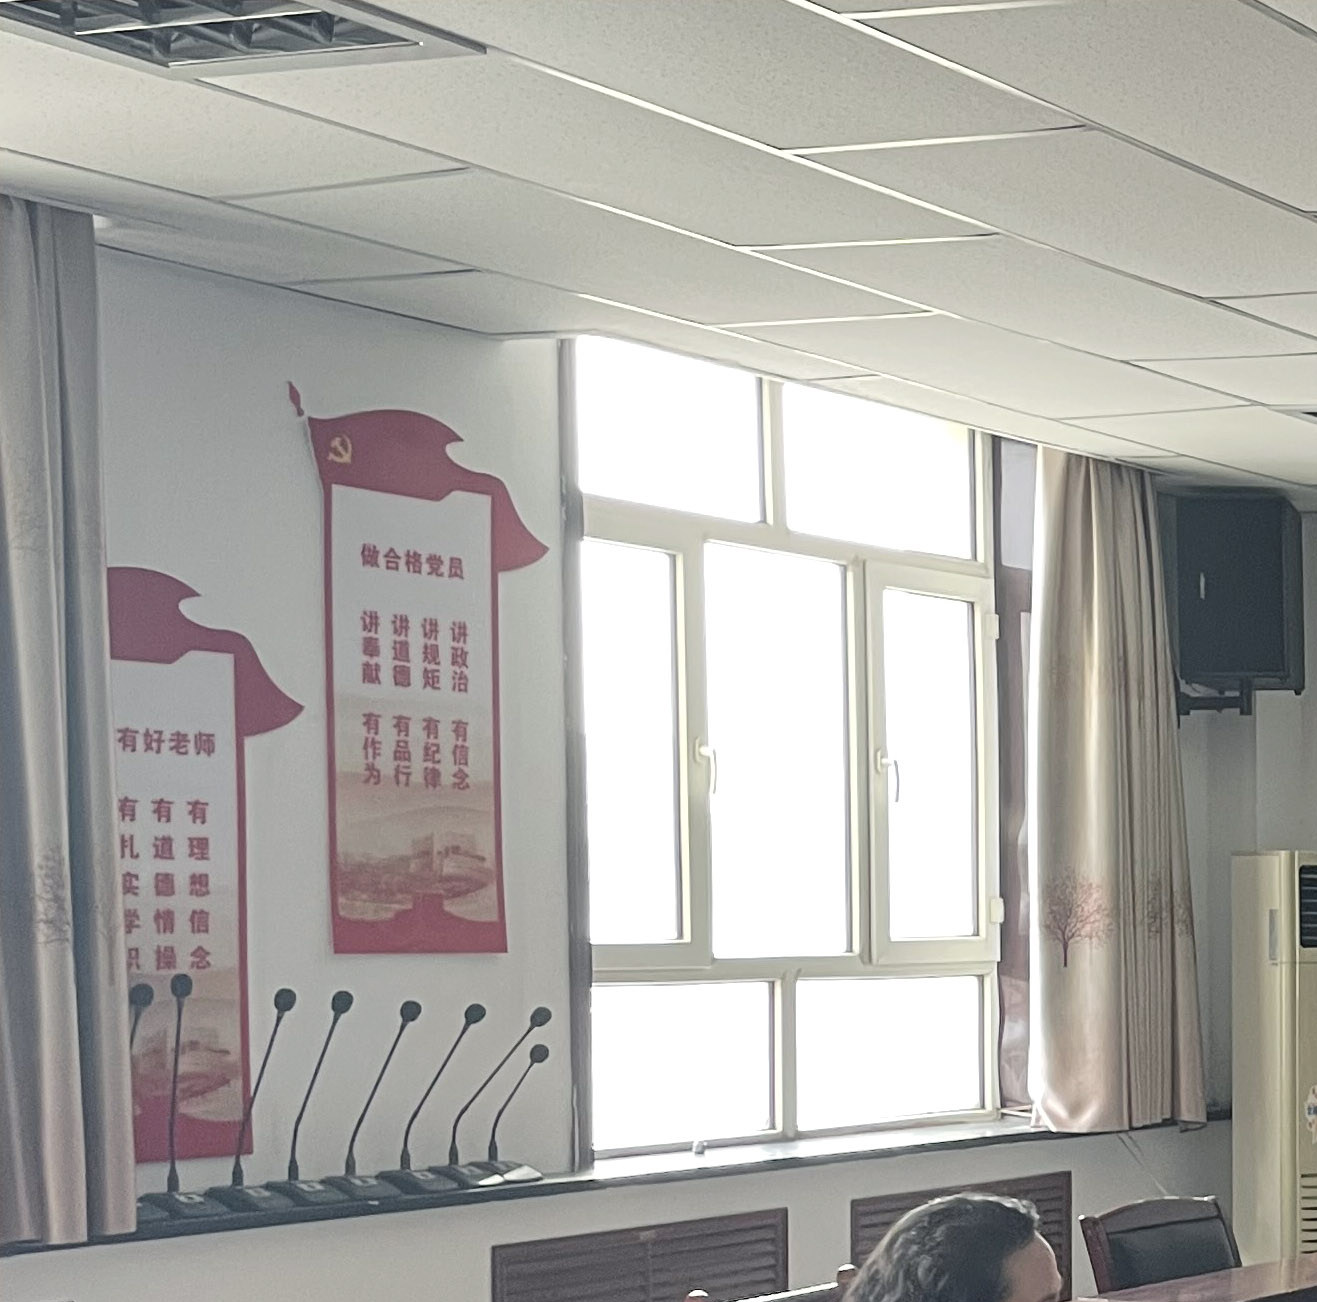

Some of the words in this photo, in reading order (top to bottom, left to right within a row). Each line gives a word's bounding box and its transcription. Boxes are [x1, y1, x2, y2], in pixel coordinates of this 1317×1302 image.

[361, 543, 464, 580] 做合格党员
[361, 610, 381, 685] 讲奉献
[391, 614, 411, 688] 讲道德
[421, 617, 441, 690] 讲规矩
[450, 621, 470, 693] 讲政治
[117, 727, 216, 757] 有好老师
[362, 712, 382, 786] 有作为
[392, 714, 412, 787] 有品行
[422, 716, 441, 790] 有纪律
[451, 719, 470, 790] 有信念
[152, 798, 177, 971] 有道德情操
[187, 799, 212, 971] 有理想信念
